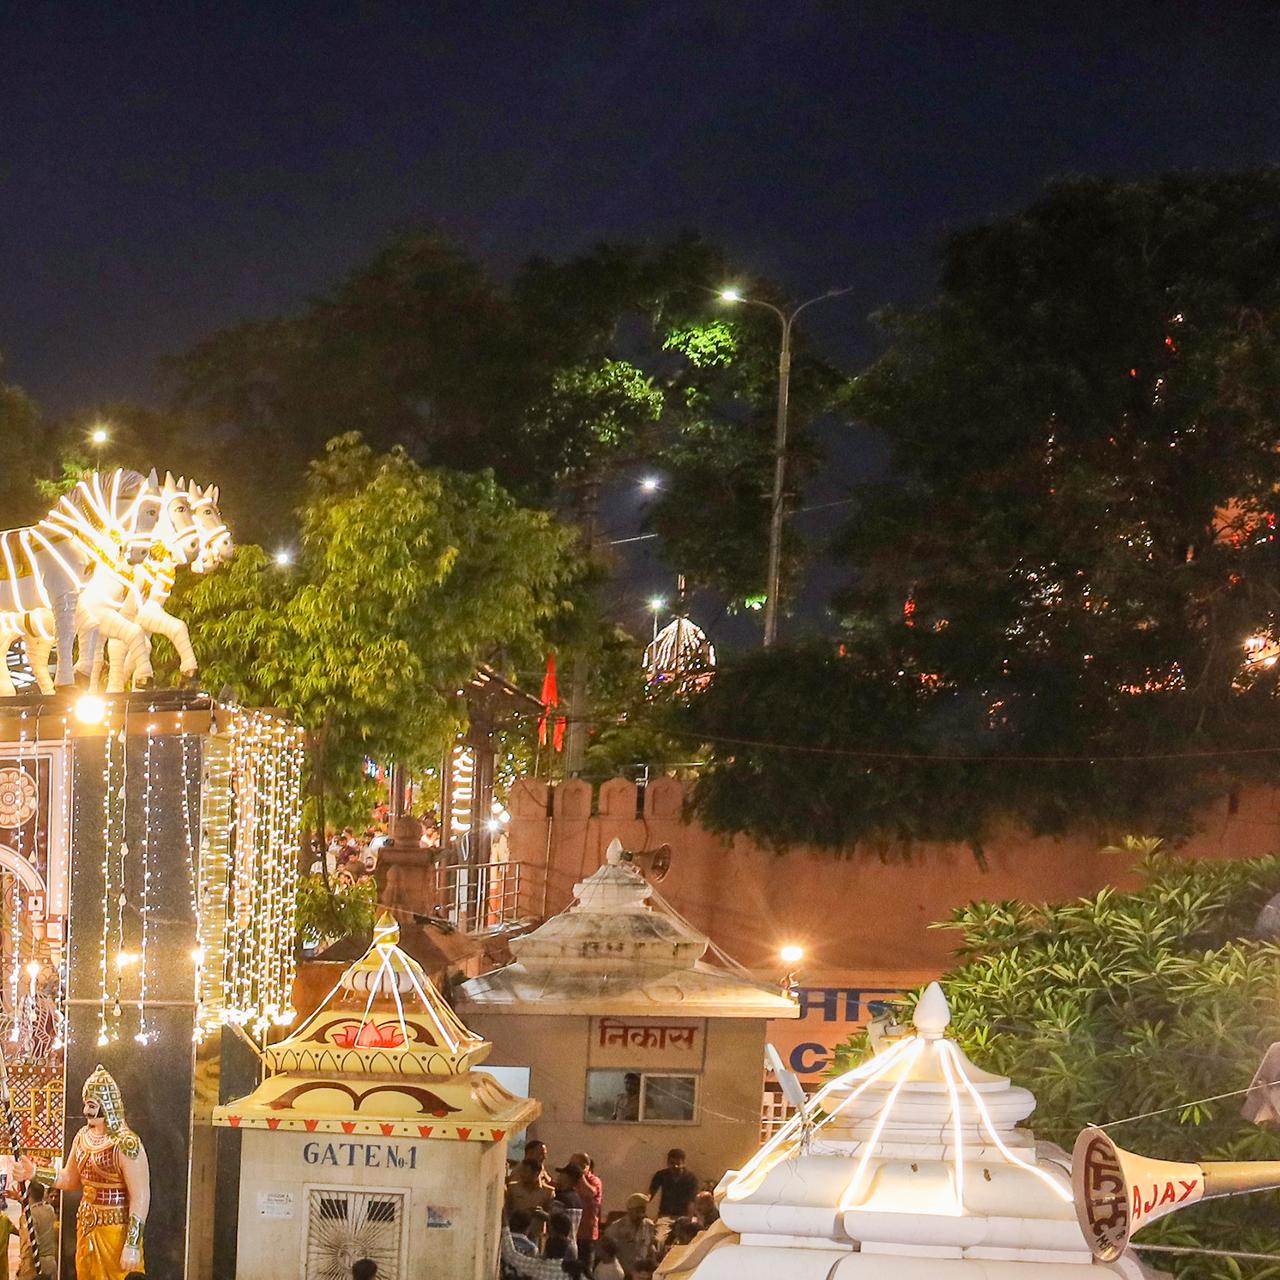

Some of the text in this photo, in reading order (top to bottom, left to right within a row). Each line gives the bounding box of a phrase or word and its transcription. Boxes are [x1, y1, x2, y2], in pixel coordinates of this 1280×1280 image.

[598, 1017, 698, 1050] निकास
[303, 1142, 382, 1168] GATE
[1131, 1179, 1199, 1221] AJAY
